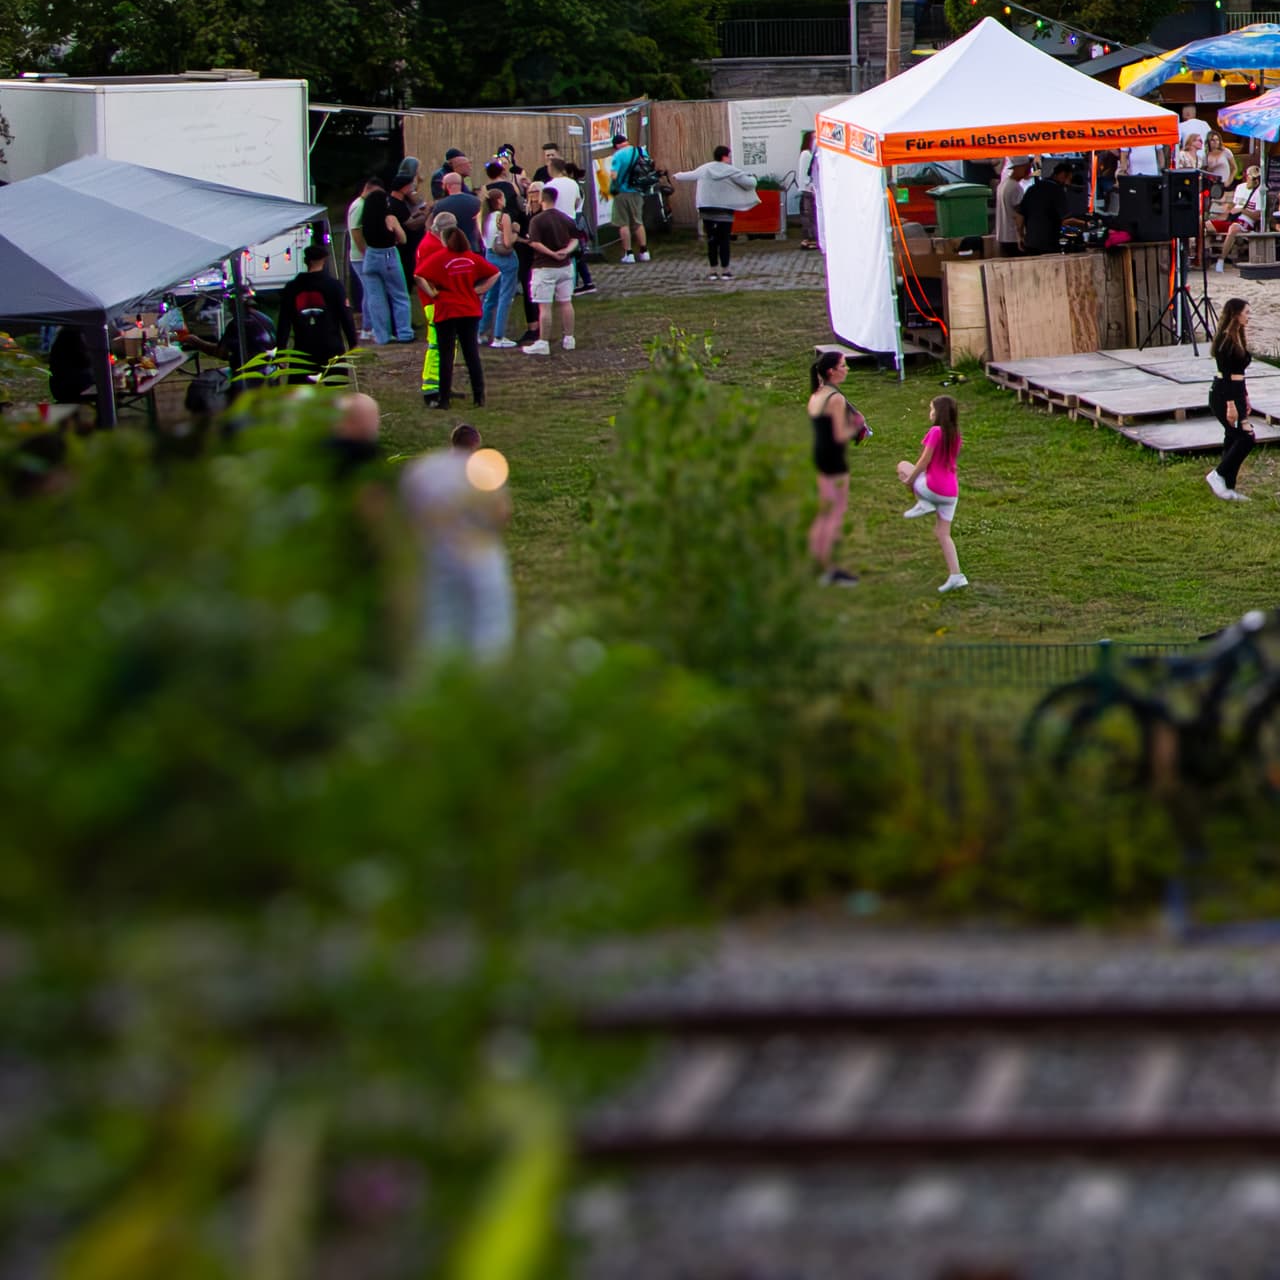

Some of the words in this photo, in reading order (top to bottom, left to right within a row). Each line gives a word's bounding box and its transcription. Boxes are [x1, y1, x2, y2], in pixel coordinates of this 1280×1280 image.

[905, 138, 935, 152] Für
[939, 136, 966, 149] ein
[971, 127, 1086, 148] lebenswertes
[1091, 123, 1158, 138] Iserlohn
